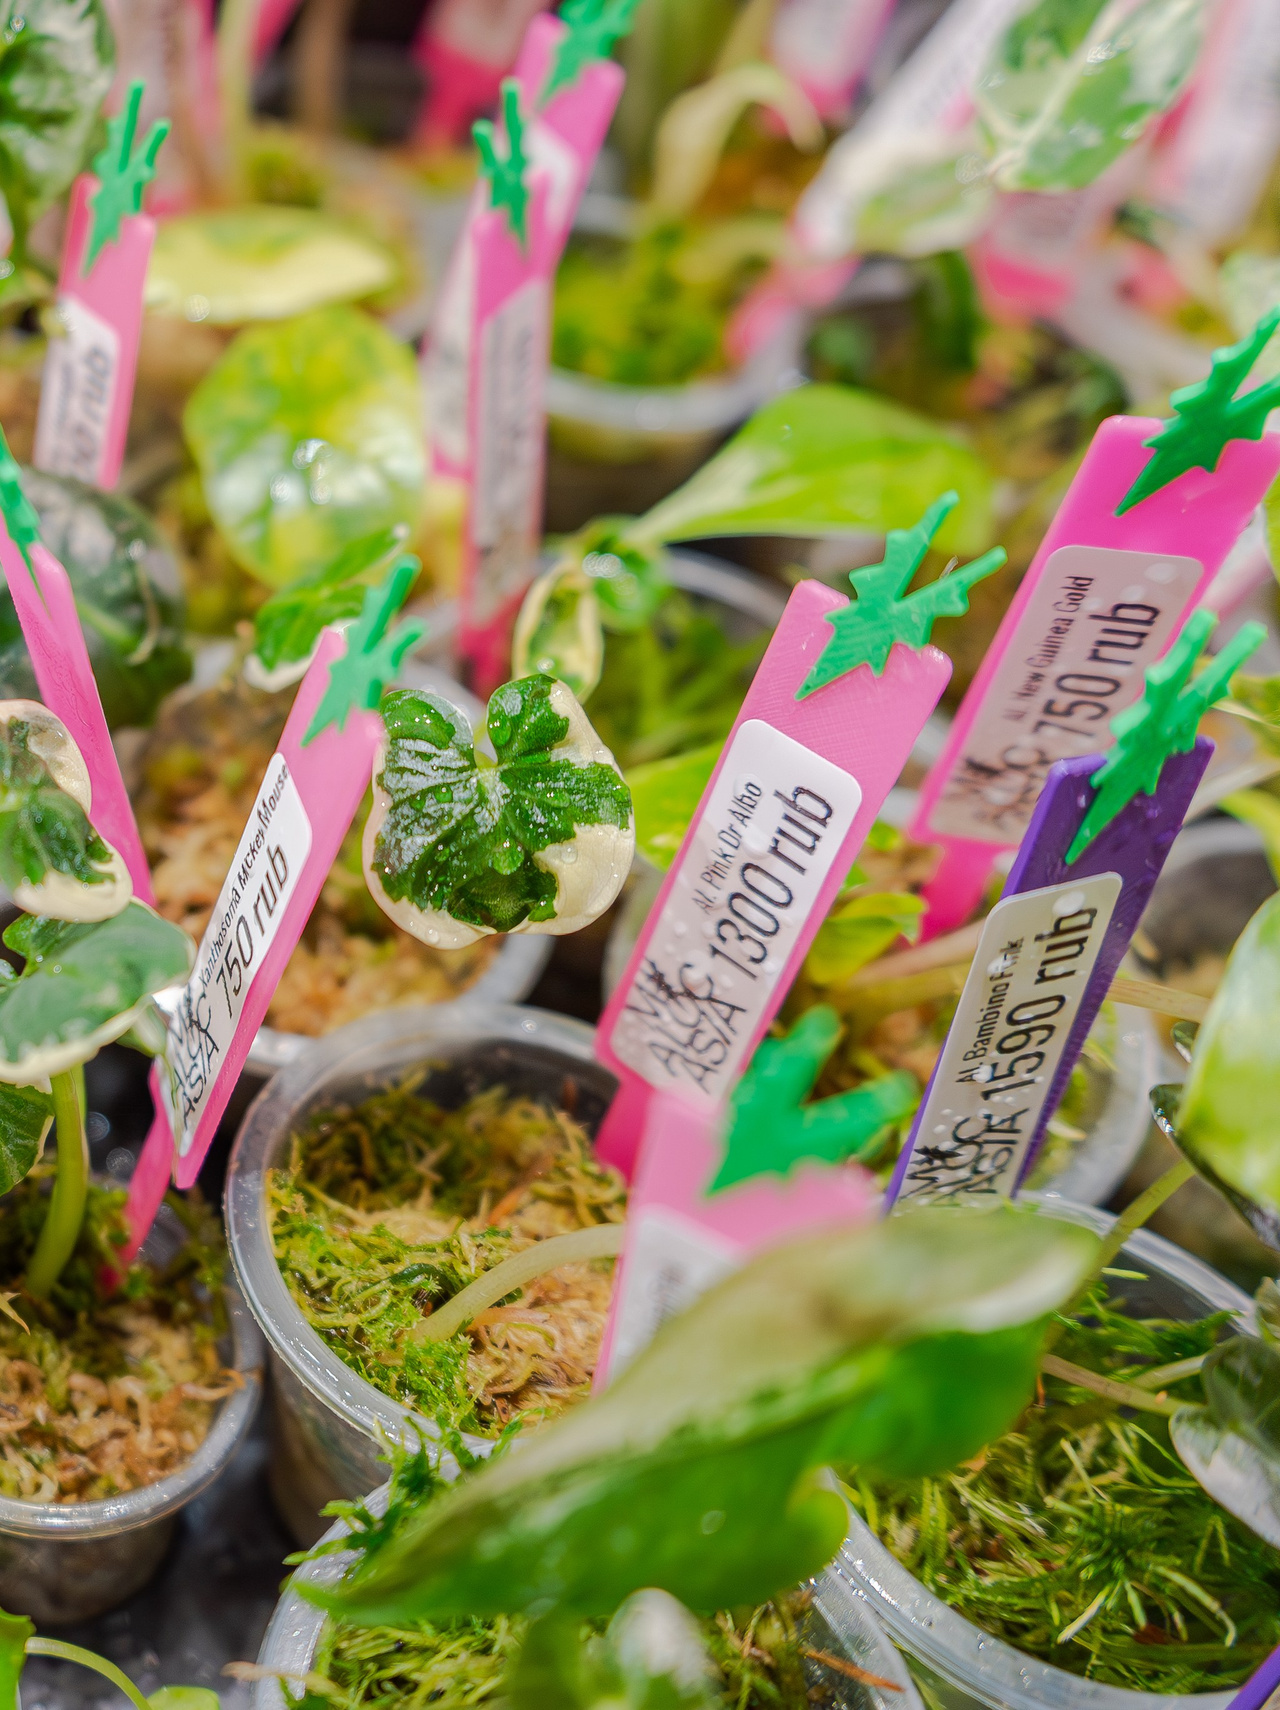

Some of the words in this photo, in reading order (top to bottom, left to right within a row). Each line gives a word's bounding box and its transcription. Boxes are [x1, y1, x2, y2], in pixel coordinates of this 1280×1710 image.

[1026, 617, 1075, 669] Guinea
[1051, 575, 1095, 613] Gold
[1032, 673, 1122, 737] 750
[1087, 602, 1161, 666] rub
[717, 823, 743, 850] Dr
[727, 781, 762, 828] Albo
[199, 886, 242, 988] Xanthosoma
[257, 764, 289, 830] Mouse
[700, 848, 735, 891] Pink
[708, 862, 793, 980] 1300
[767, 786, 833, 876] rub
[216, 914, 254, 1019] 750
[253, 843, 290, 937] rub
[963, 981, 1010, 1062] Bambino
[980, 994, 1066, 1101] 1590
[1034, 907, 1098, 985] rub
